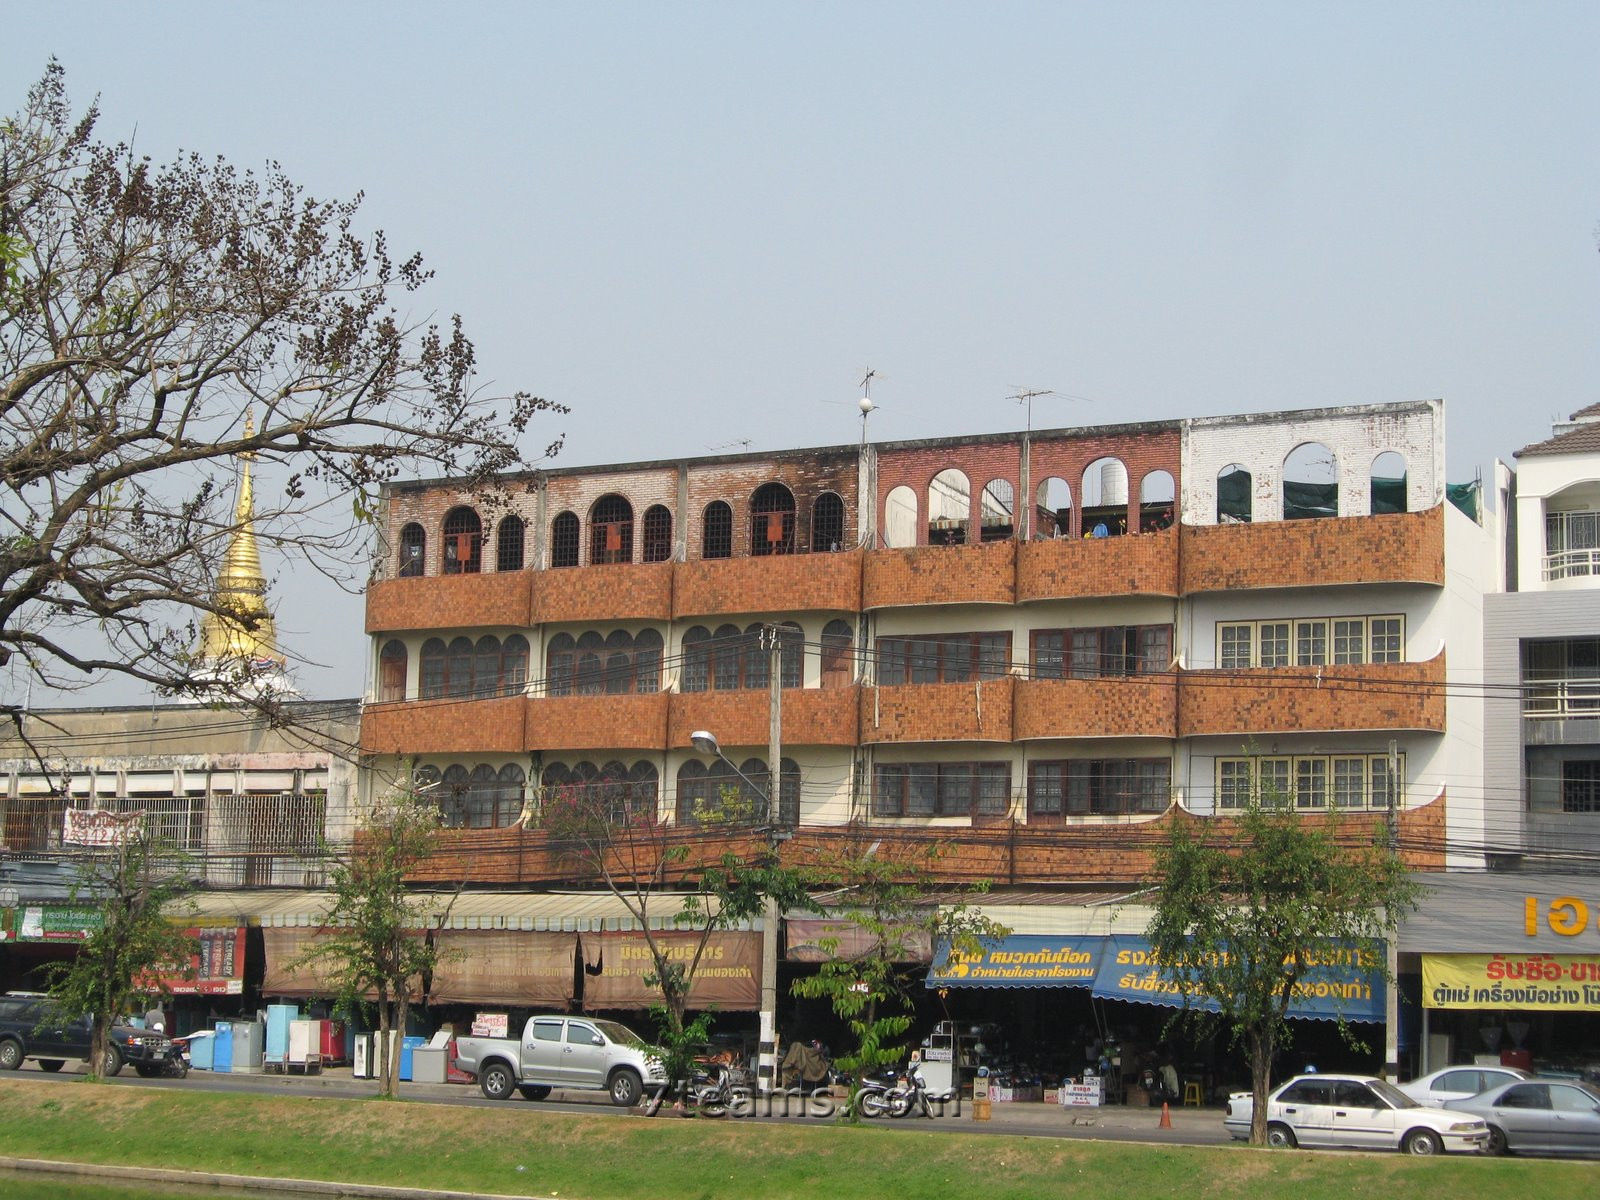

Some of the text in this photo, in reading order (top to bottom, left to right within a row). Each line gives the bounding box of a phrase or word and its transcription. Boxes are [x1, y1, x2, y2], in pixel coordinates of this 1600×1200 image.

[1525, 895, 1600, 937] เอ
[1486, 954, 1600, 982] รับซื้อ-ขา
[1473, 981, 1580, 1005] เครื่องมือช่าง
